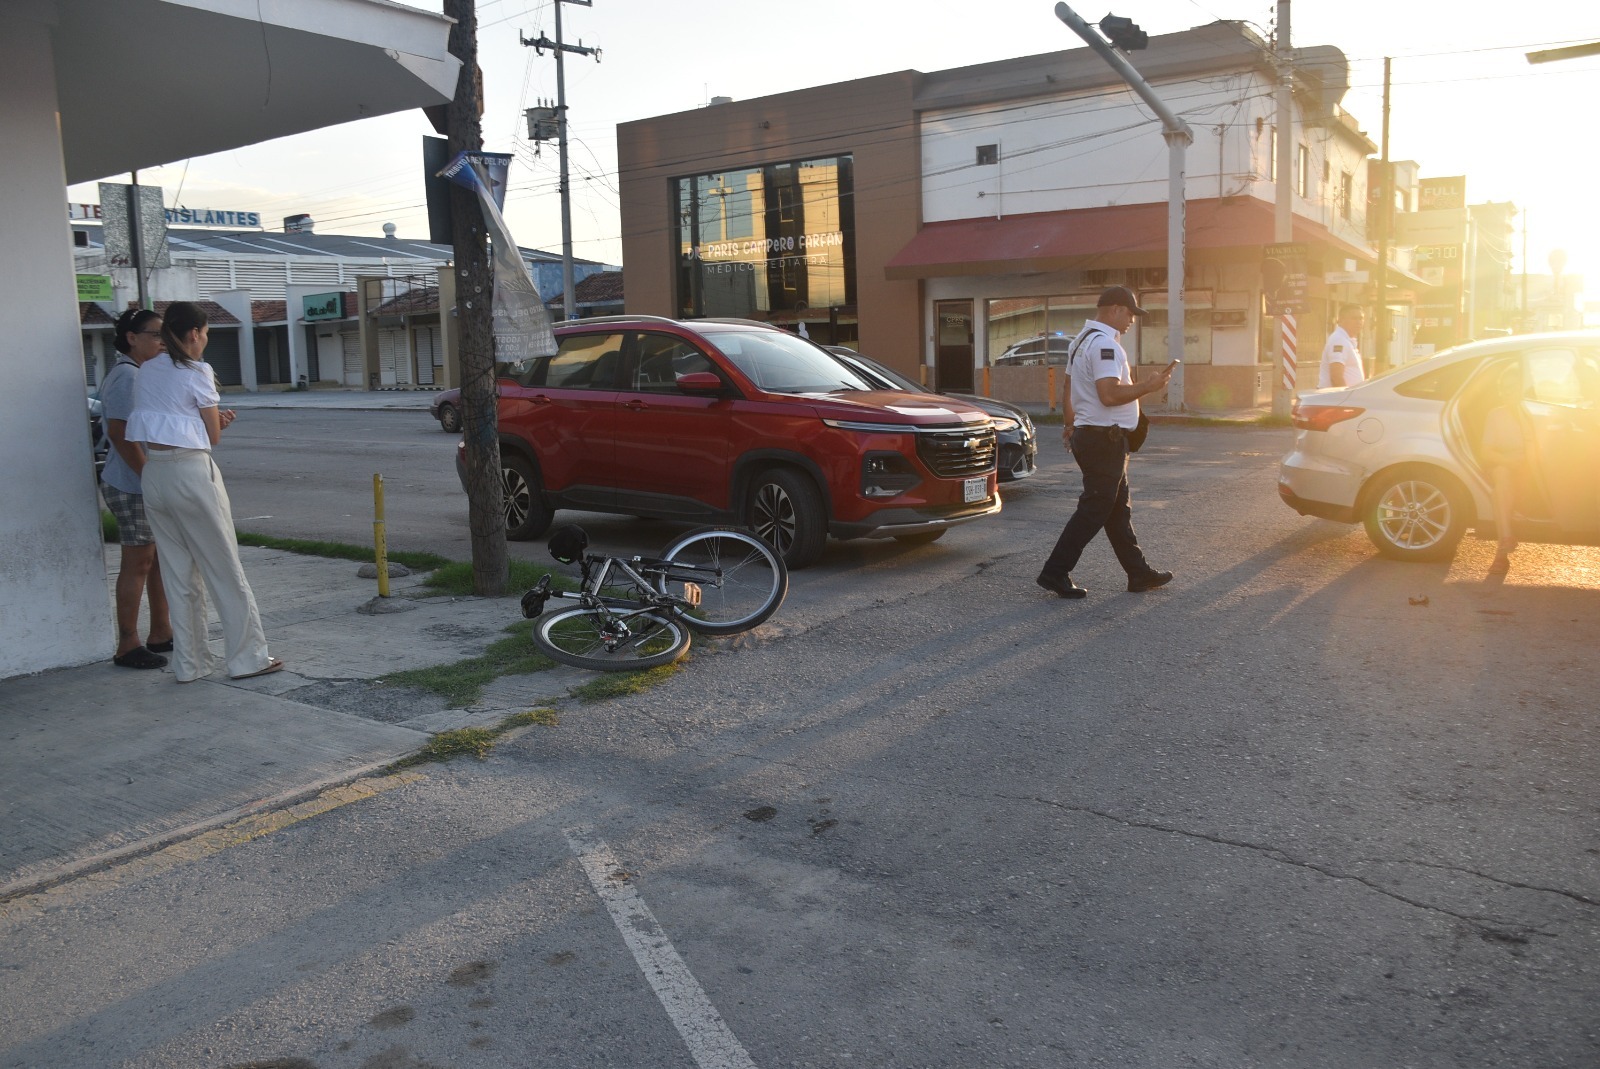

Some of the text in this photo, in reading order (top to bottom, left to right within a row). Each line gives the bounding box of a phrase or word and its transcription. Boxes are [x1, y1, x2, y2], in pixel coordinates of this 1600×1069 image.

[1424, 185, 1458, 197] FULL
[165, 208, 258, 226] AISLANTES
[708, 242, 739, 258] PARIS
